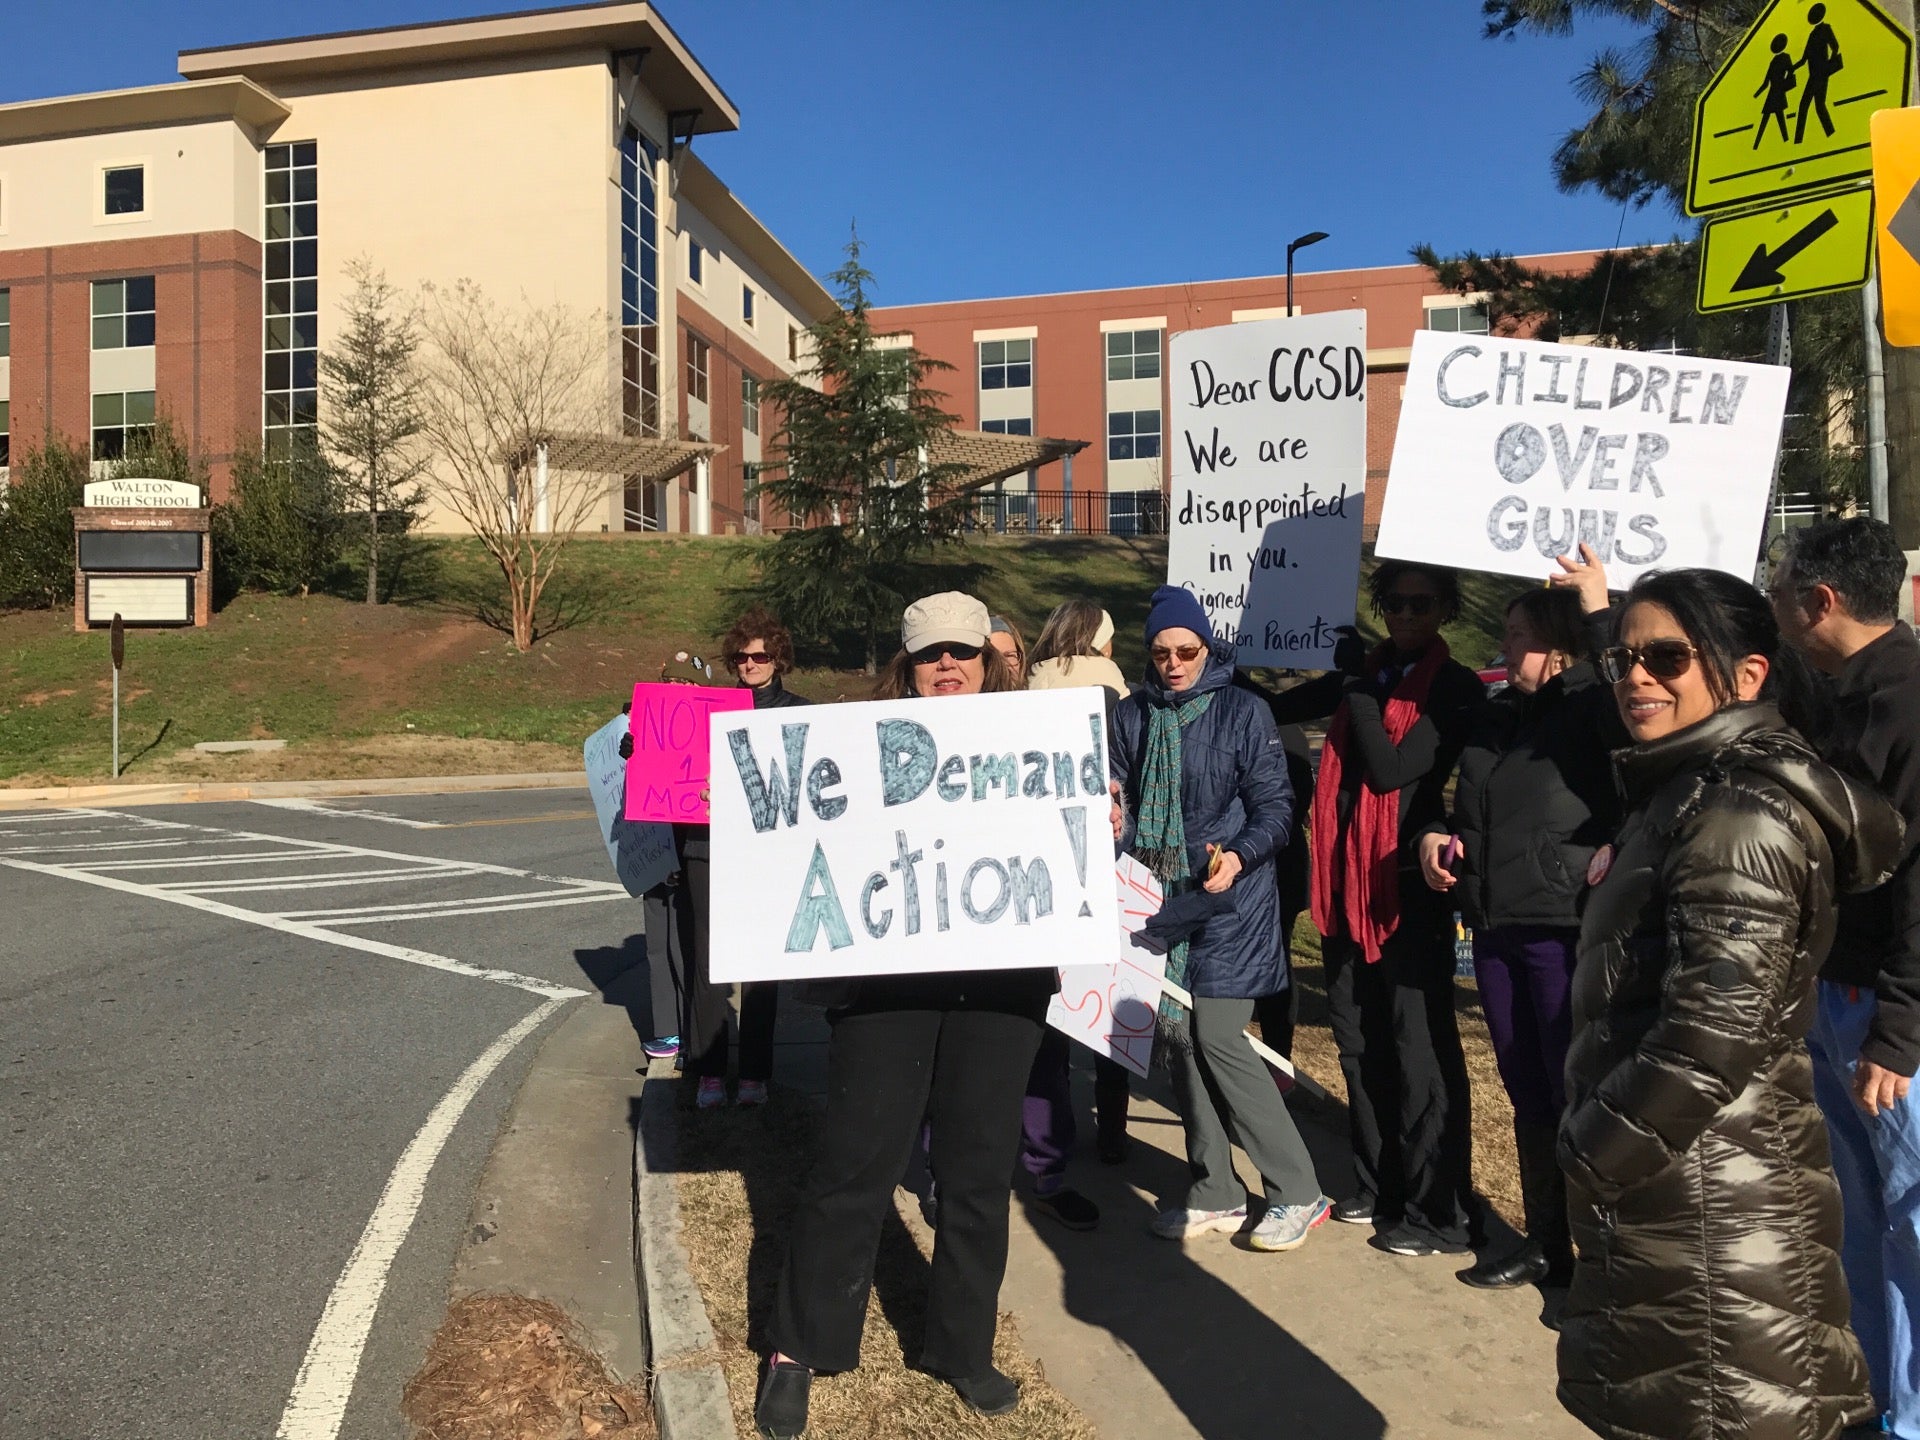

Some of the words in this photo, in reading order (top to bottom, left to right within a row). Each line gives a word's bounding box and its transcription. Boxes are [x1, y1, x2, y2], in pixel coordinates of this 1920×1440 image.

[1189, 359, 1262, 408] Dear
[1437, 345, 1749, 426] CHILDREN
[1185, 427, 1237, 474] We
[1259, 438, 1308, 463] are
[1494, 422, 1670, 498] OVER
[93, 495, 131, 506] HIGH
[135, 495, 193, 507] SCHOOL
[112, 481, 173, 492] WALTON
[1178, 483, 1348, 534] disappointed
[1487, 495, 1667, 565] GUNS
[1209, 544, 1232, 573] in
[1247, 546, 1298, 583] you.
[1264, 615, 1336, 651] Parents
[641, 697, 726, 751] NOT
[674, 754, 707, 784] 1
[727, 722, 848, 833] We
[876, 712, 1107, 807] Demand
[784, 806, 1093, 953] Action!
